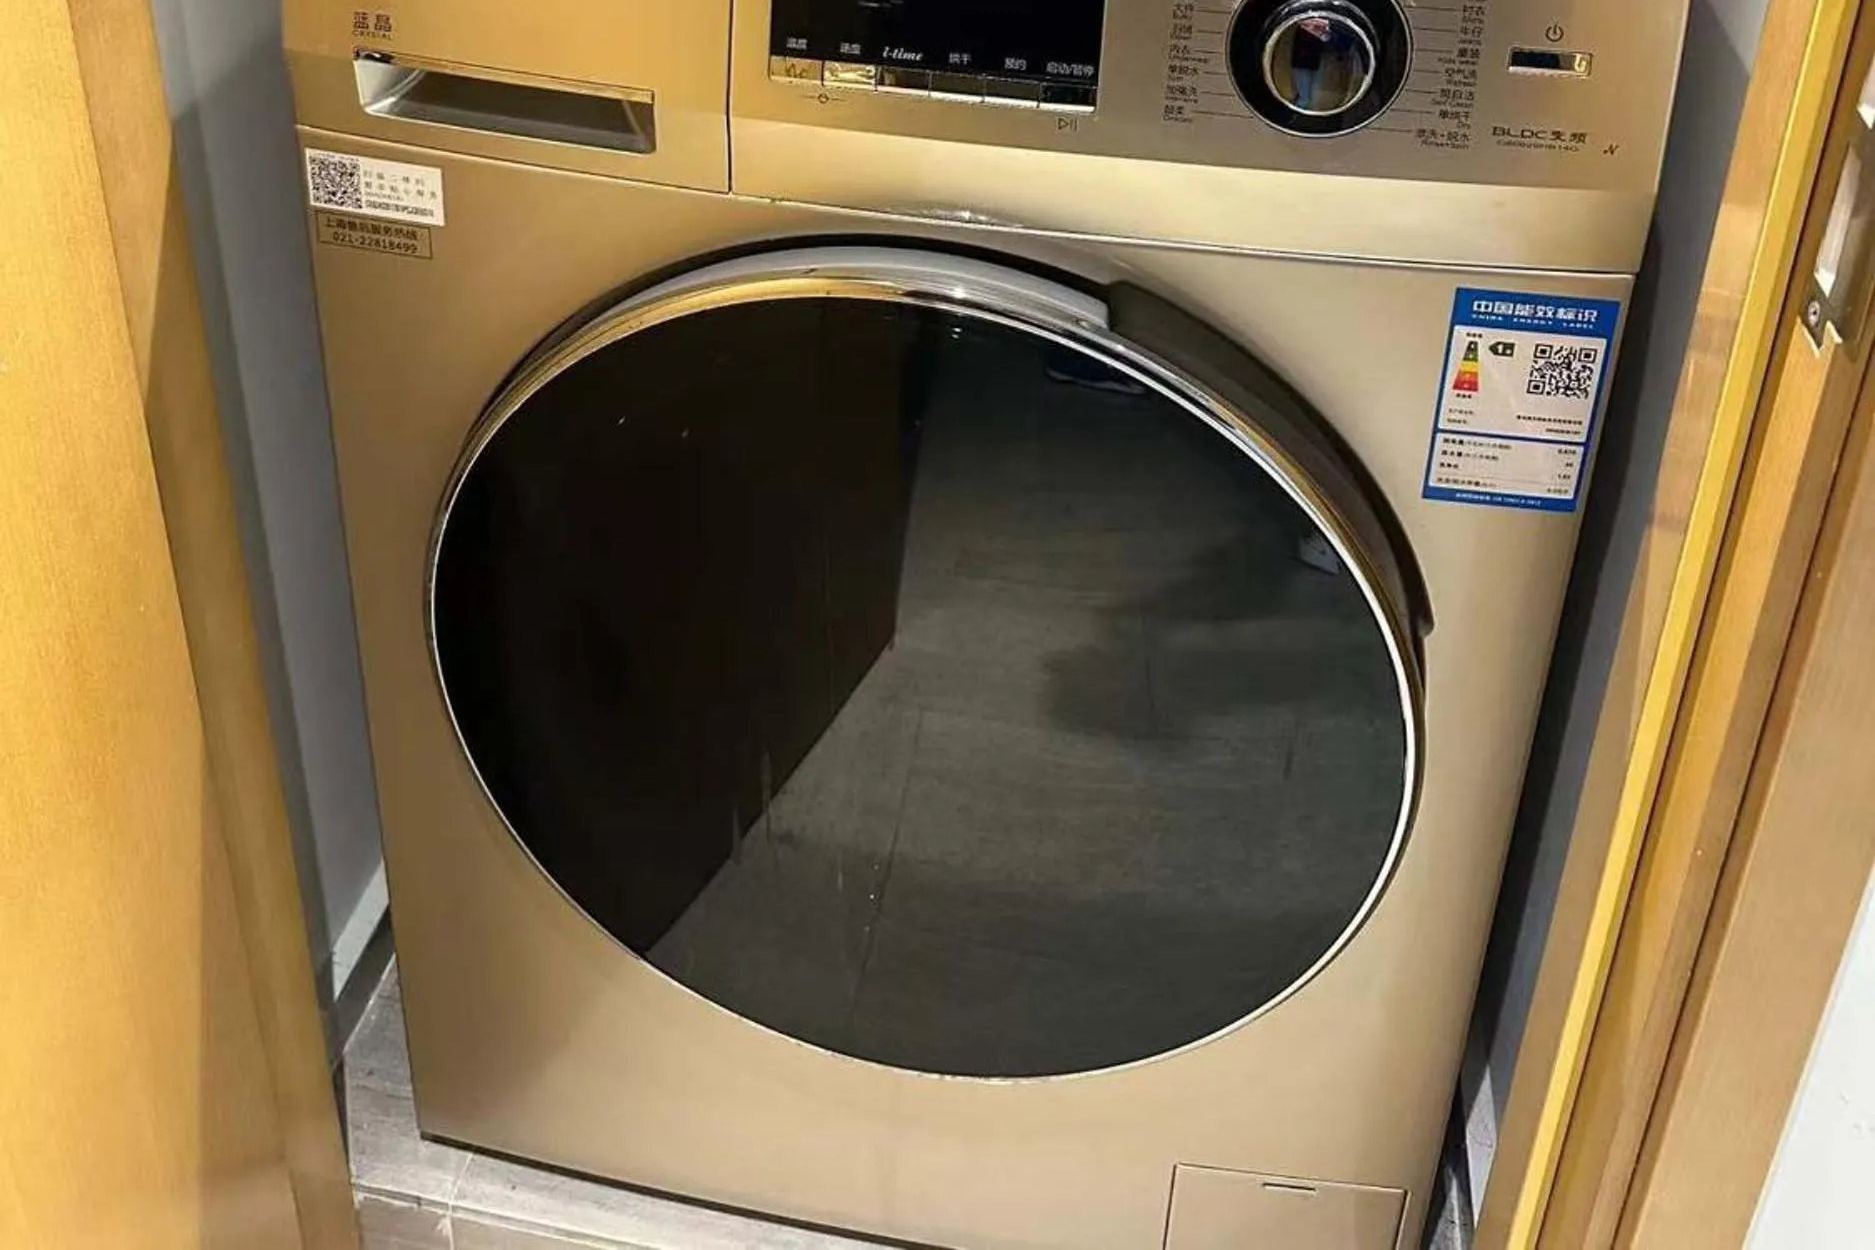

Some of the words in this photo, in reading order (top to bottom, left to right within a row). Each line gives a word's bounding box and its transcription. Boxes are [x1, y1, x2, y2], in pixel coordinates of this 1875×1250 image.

[352, 30, 392, 41] CRYSTAL
[1472, 301, 1598, 323] 中国能效标识
